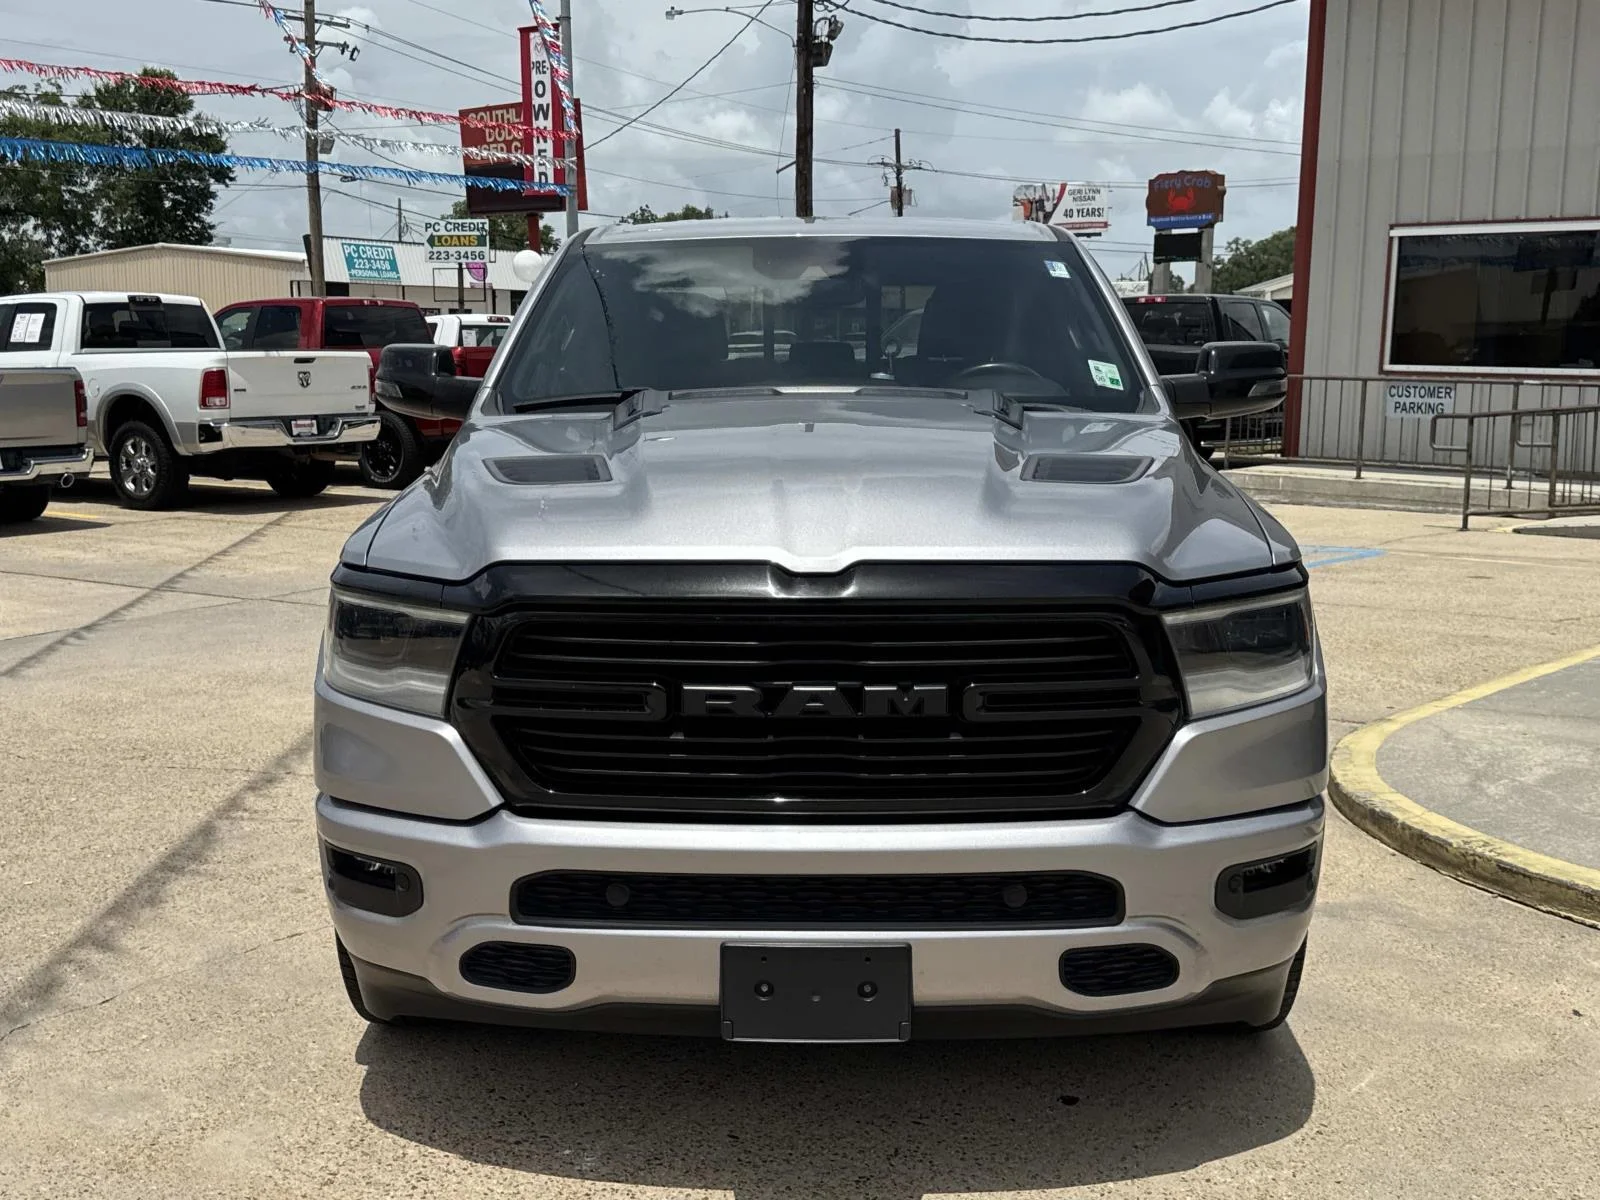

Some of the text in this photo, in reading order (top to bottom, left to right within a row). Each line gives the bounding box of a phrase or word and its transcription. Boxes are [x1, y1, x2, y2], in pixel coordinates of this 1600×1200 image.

[468, 107, 523, 129] SOUTHL
[1063, 207, 1105, 219] 40 YEARS!
[424, 221, 488, 233] PC CREDIT
[434, 235, 479, 246] LOANS
[343, 244, 393, 260] PC CREDIT
[428, 250, 486, 261] 223-3456
[1388, 384, 1453, 399] CUSTOMER
[1394, 401, 1445, 415] PARKING
[682, 685, 949, 718] RAM
